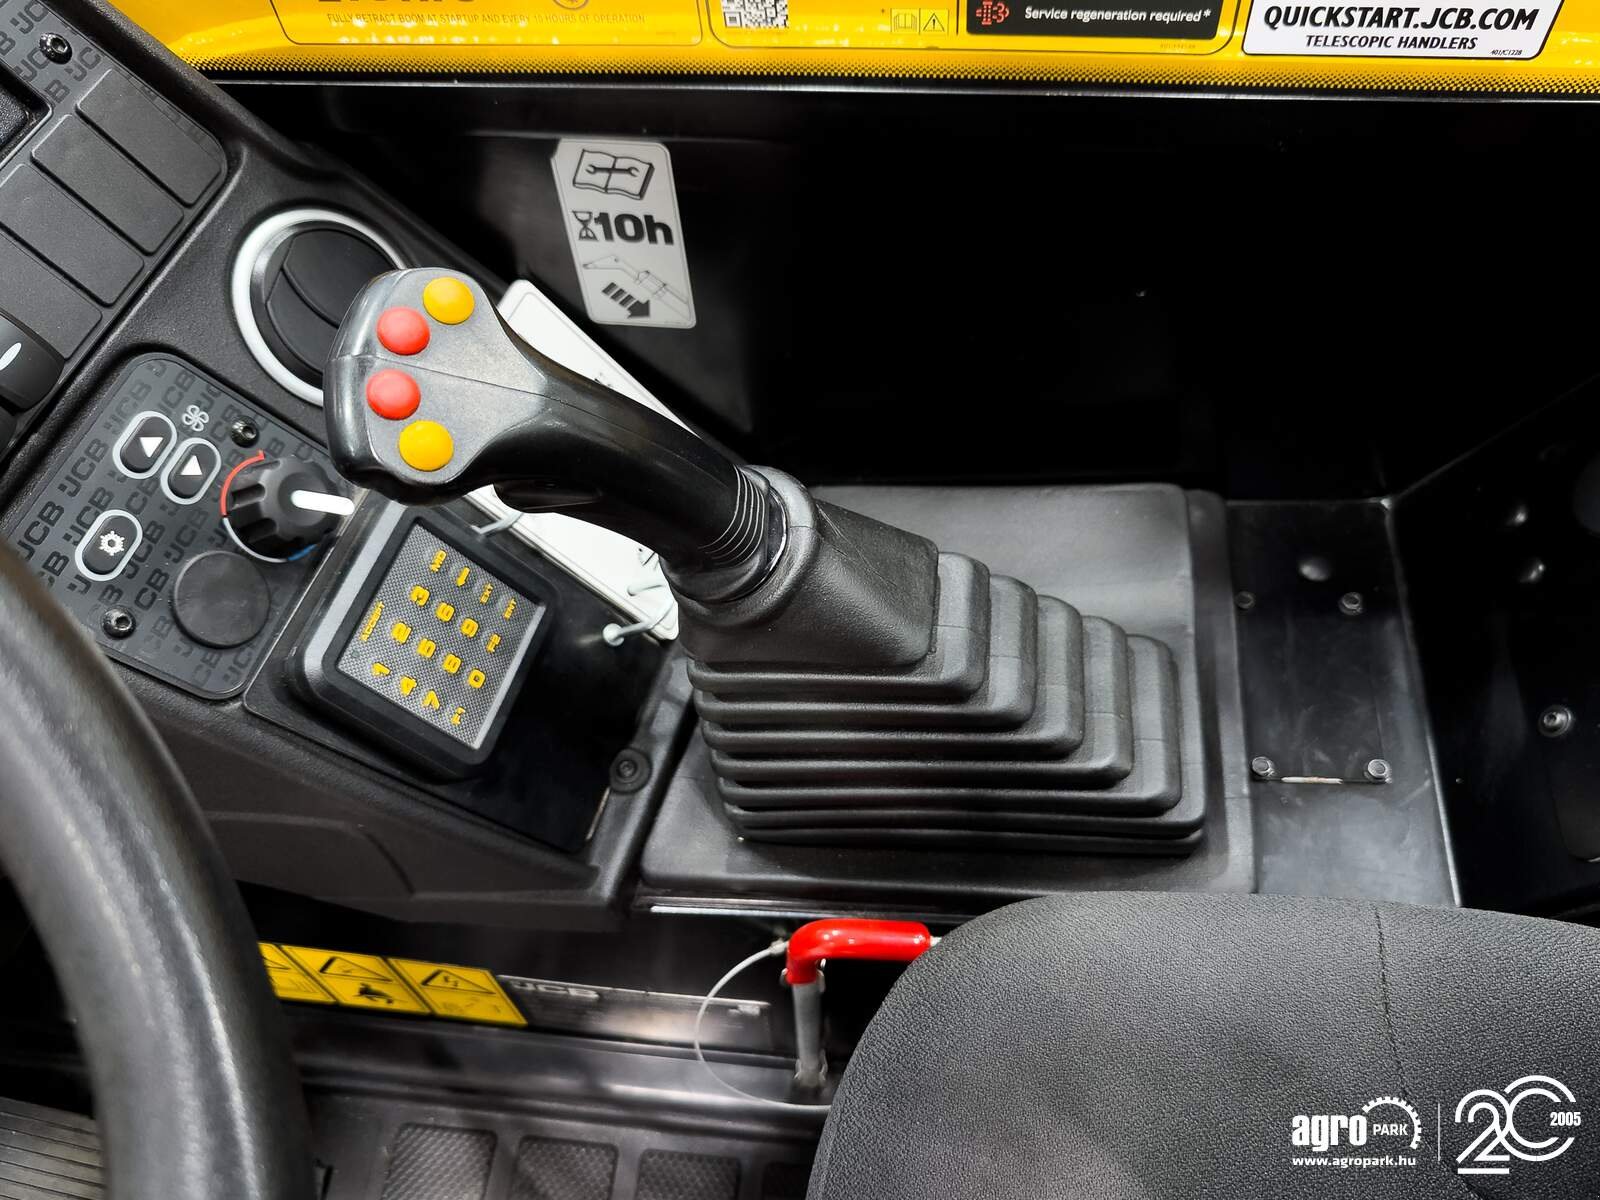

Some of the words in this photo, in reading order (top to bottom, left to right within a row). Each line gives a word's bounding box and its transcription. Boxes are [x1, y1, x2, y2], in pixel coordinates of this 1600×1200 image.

[327, 13, 353, 23] FULLY
[440, 13, 478, 23] STARTUP
[482, 14, 500, 23] AND
[546, 14, 577, 23] HOURS
[594, 14, 645, 23] OPERATION
[1025, 6, 1067, 20] Service
[1070, 9, 1147, 22] regeneration
[1264, 6, 1539, 30] QUICKSTART.JCB.COM
[1306, 35, 1394, 48] TELESCOPIC
[1397, 36, 1478, 49] HANDLERS
[594, 212, 674, 245] 10h
[57, 438, 109, 497] JCB
[410, 585, 430, 607] 3
[480, 582, 493, 604] EXT
[435, 602, 455, 622] 6
[503, 598, 517, 620] ENT
[359, 600, 385, 642] ACCEPT
[460, 618, 479, 638] 9
[391, 621, 412, 644] 2
[486, 633, 501, 653] F2
[417, 638, 436, 659] 5
[371, 662, 391, 676] 1
[442, 653, 462, 674] 8
[399, 676, 418, 696] 4
[422, 689, 440, 710] 7
